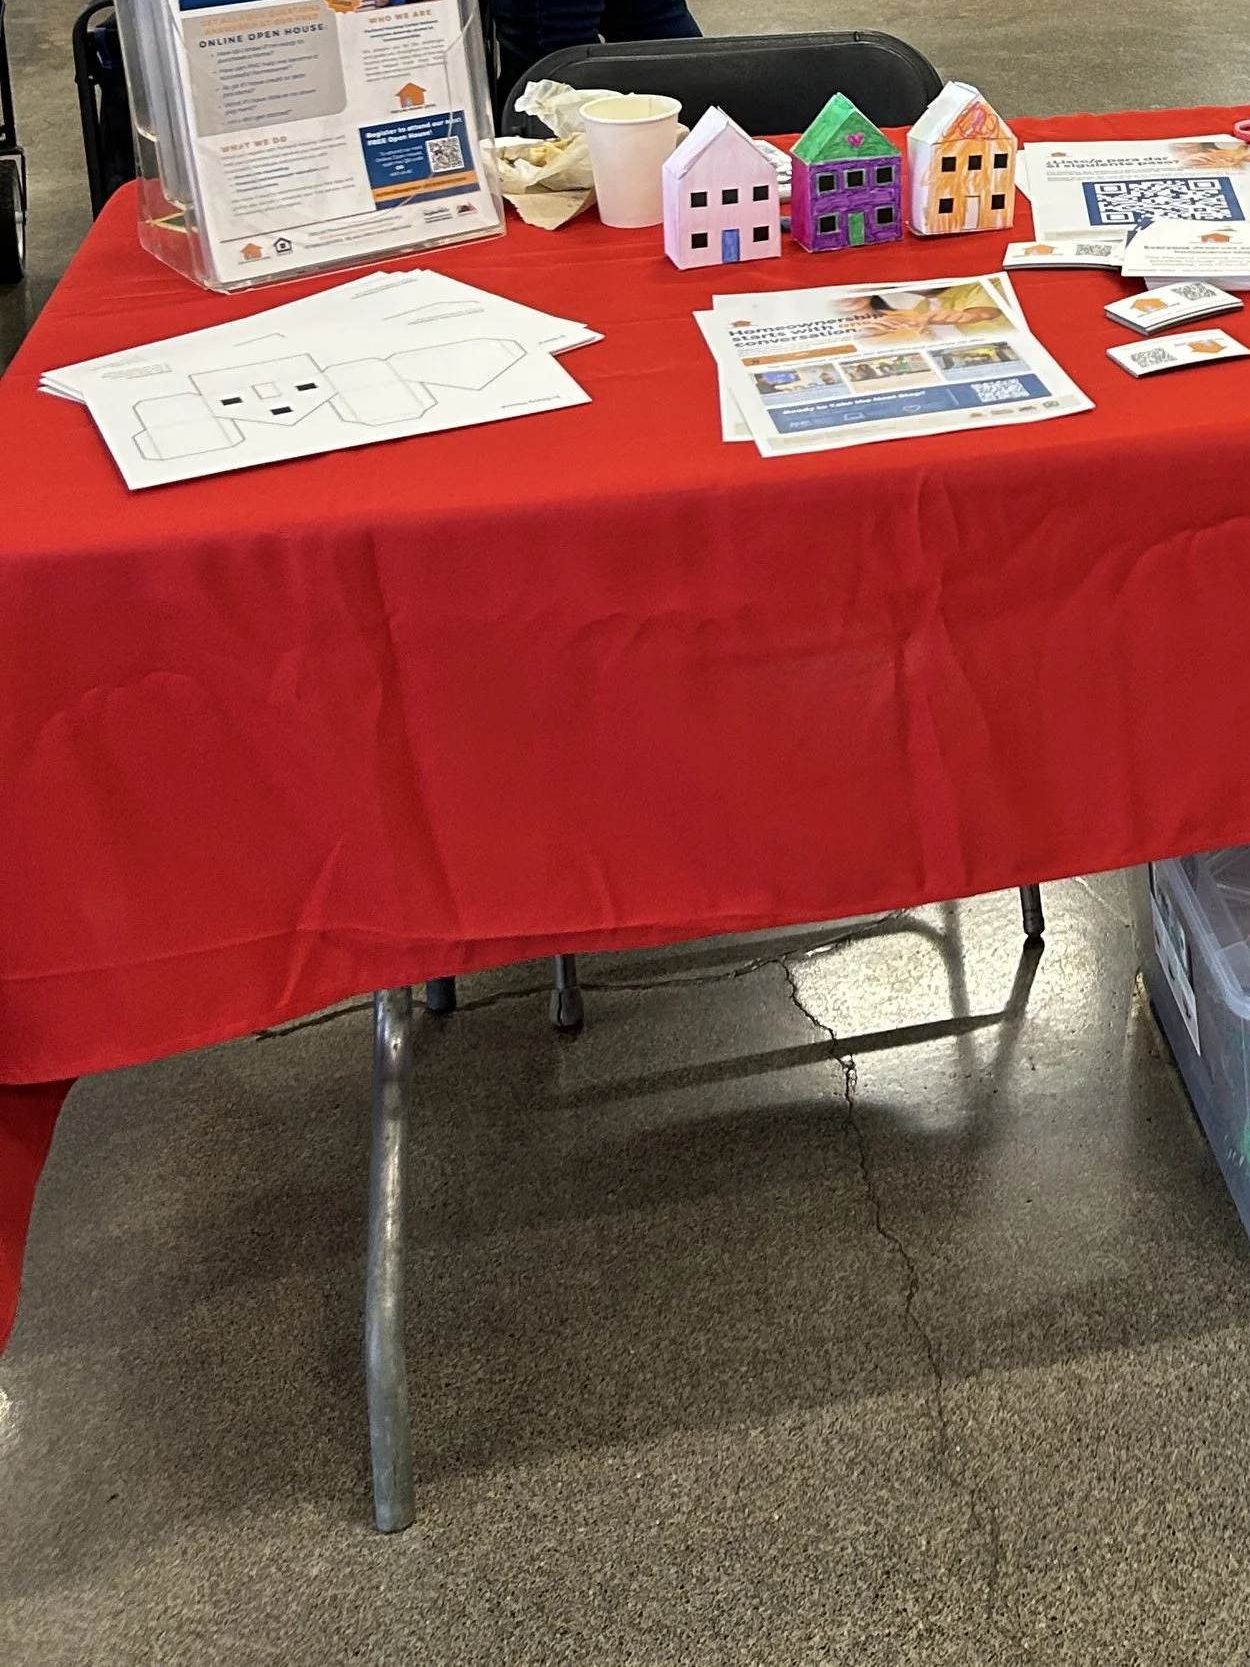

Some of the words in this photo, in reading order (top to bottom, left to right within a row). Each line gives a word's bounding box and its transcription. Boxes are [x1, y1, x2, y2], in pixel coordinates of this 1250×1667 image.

[369, 15, 392, 23] WHO
[412, 9, 432, 17] ARE
[199, 35, 243, 49] ONLINE
[248, 30, 280, 42] OPEN
[221, 142, 250, 153] WHAT
[253, 139, 268, 147] WE
[272, 136, 287, 144] DO
[728, 312, 884, 337] Homeownership
[731, 330, 787, 342] starts
[791, 325, 834, 335] with
